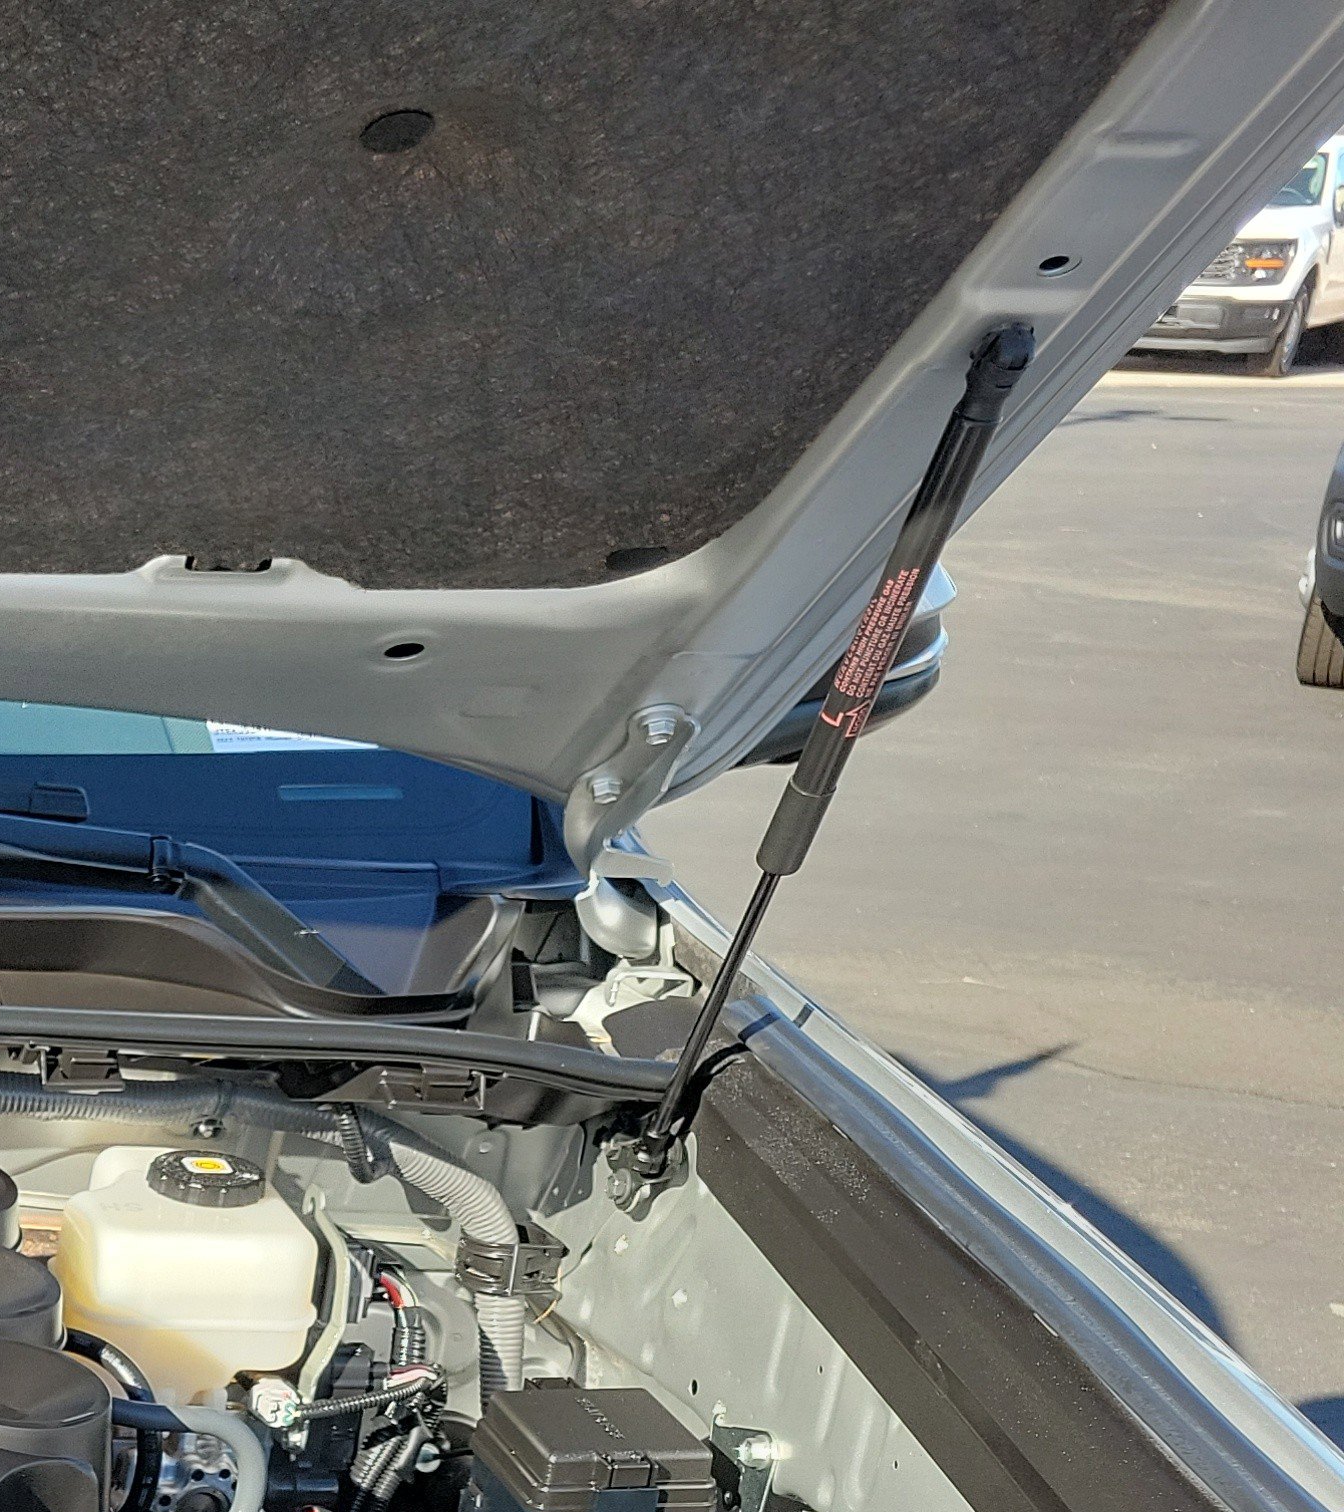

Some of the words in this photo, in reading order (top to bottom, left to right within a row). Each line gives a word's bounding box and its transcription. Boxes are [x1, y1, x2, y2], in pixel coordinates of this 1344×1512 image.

[839, 656, 860, 693] CONTAINS
[864, 597, 885, 637] PRESSURE
[883, 579, 894, 597] GAS
[846, 684, 857, 697] DO
[853, 669, 865, 684] NOT
[860, 627, 881, 668] PUNCTURE
[884, 570, 910, 615] INCINERATE
[856, 661, 877, 698] CONTIENT
[878, 632, 890, 649] GAZ
[897, 568, 920, 606] PRESSION
[820, 711, 843, 726] L
